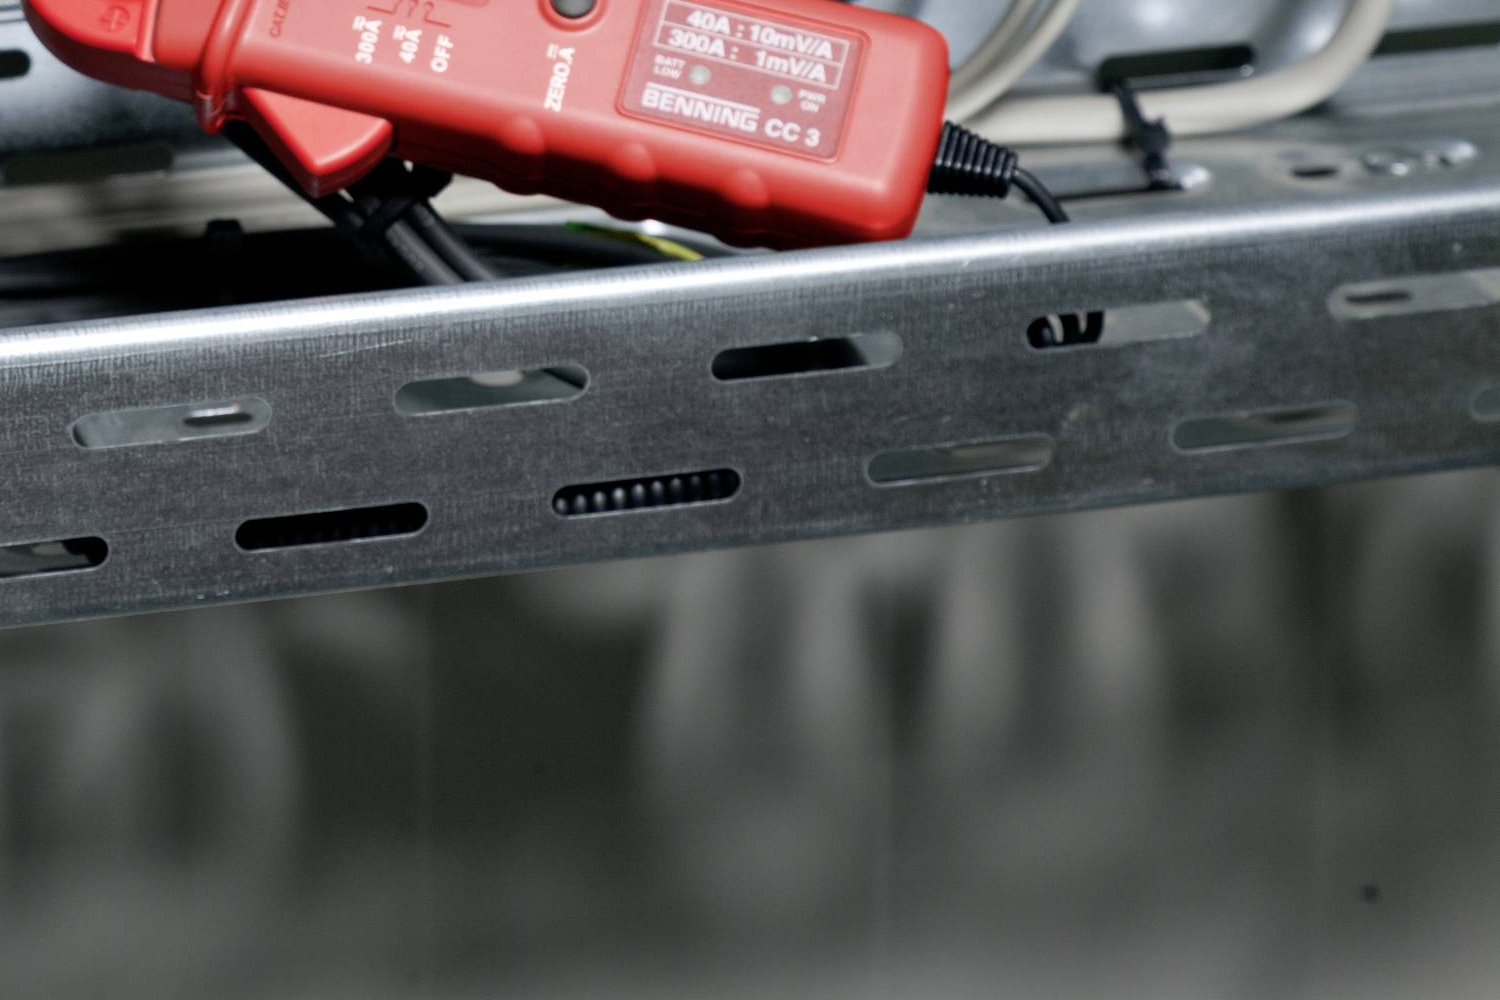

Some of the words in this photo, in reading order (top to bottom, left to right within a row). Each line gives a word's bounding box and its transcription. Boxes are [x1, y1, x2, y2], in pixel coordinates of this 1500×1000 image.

[355, 19, 382, 65] 300A
[399, 27, 423, 65] 40A
[430, 34, 454, 73] OFF
[668, 28, 726, 58] 300A
[756, 49, 827, 83] 1mV/A
[687, 10, 730, 35] 40A
[750, 23, 833, 60] 10mV/A
[653, 64, 683, 79] LOW
[641, 87, 758, 132] BENNING
[764, 117, 801, 142] CC
[804, 127, 821, 148] 3
